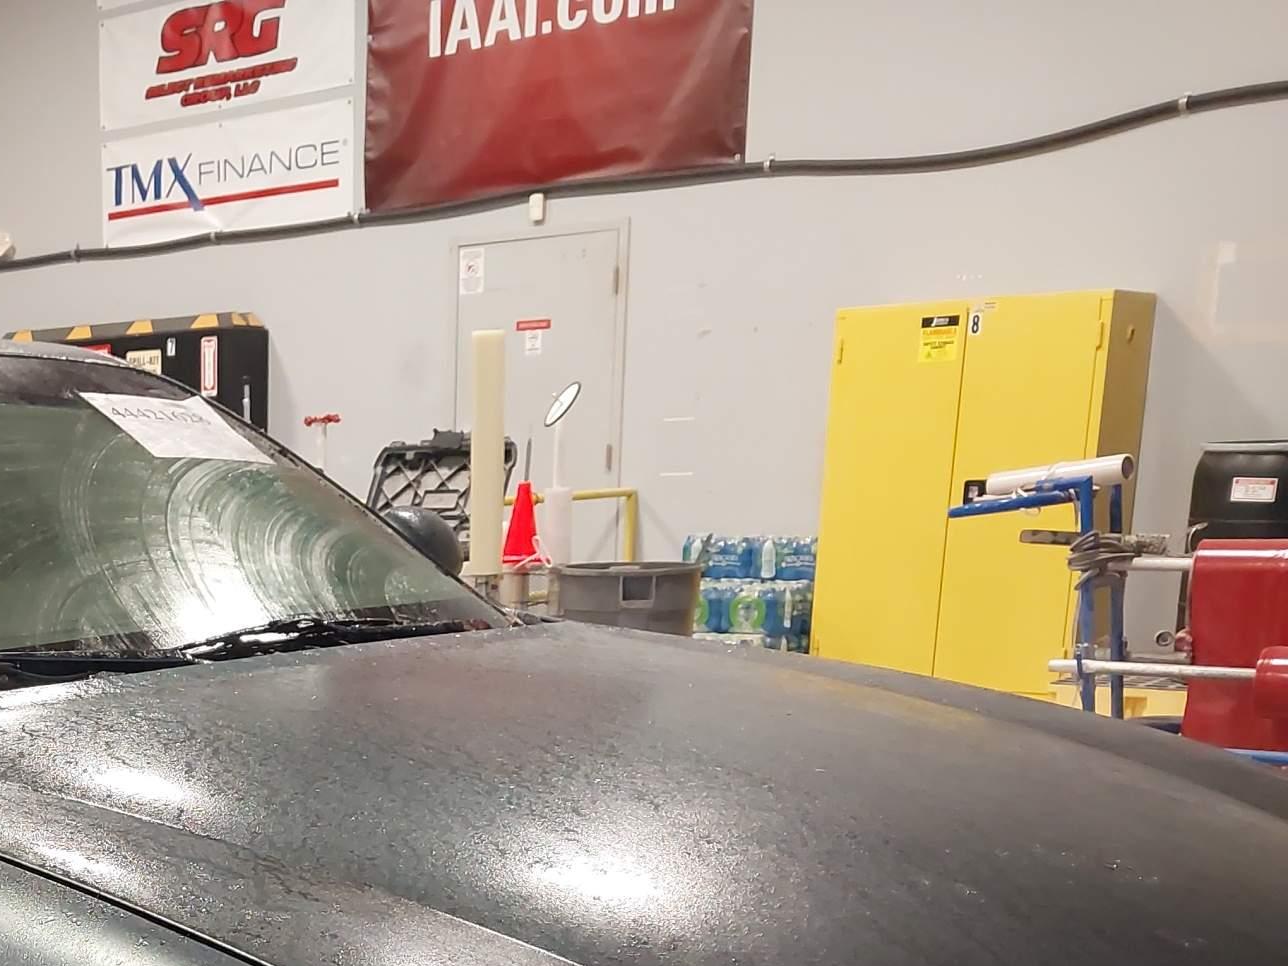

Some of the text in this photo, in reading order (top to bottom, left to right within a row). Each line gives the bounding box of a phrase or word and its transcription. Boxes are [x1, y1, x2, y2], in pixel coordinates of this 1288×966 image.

[156, 0, 285, 74] SRG
[106, 140, 340, 212] TMX FINANCE
[972, 314, 980, 334] 8
